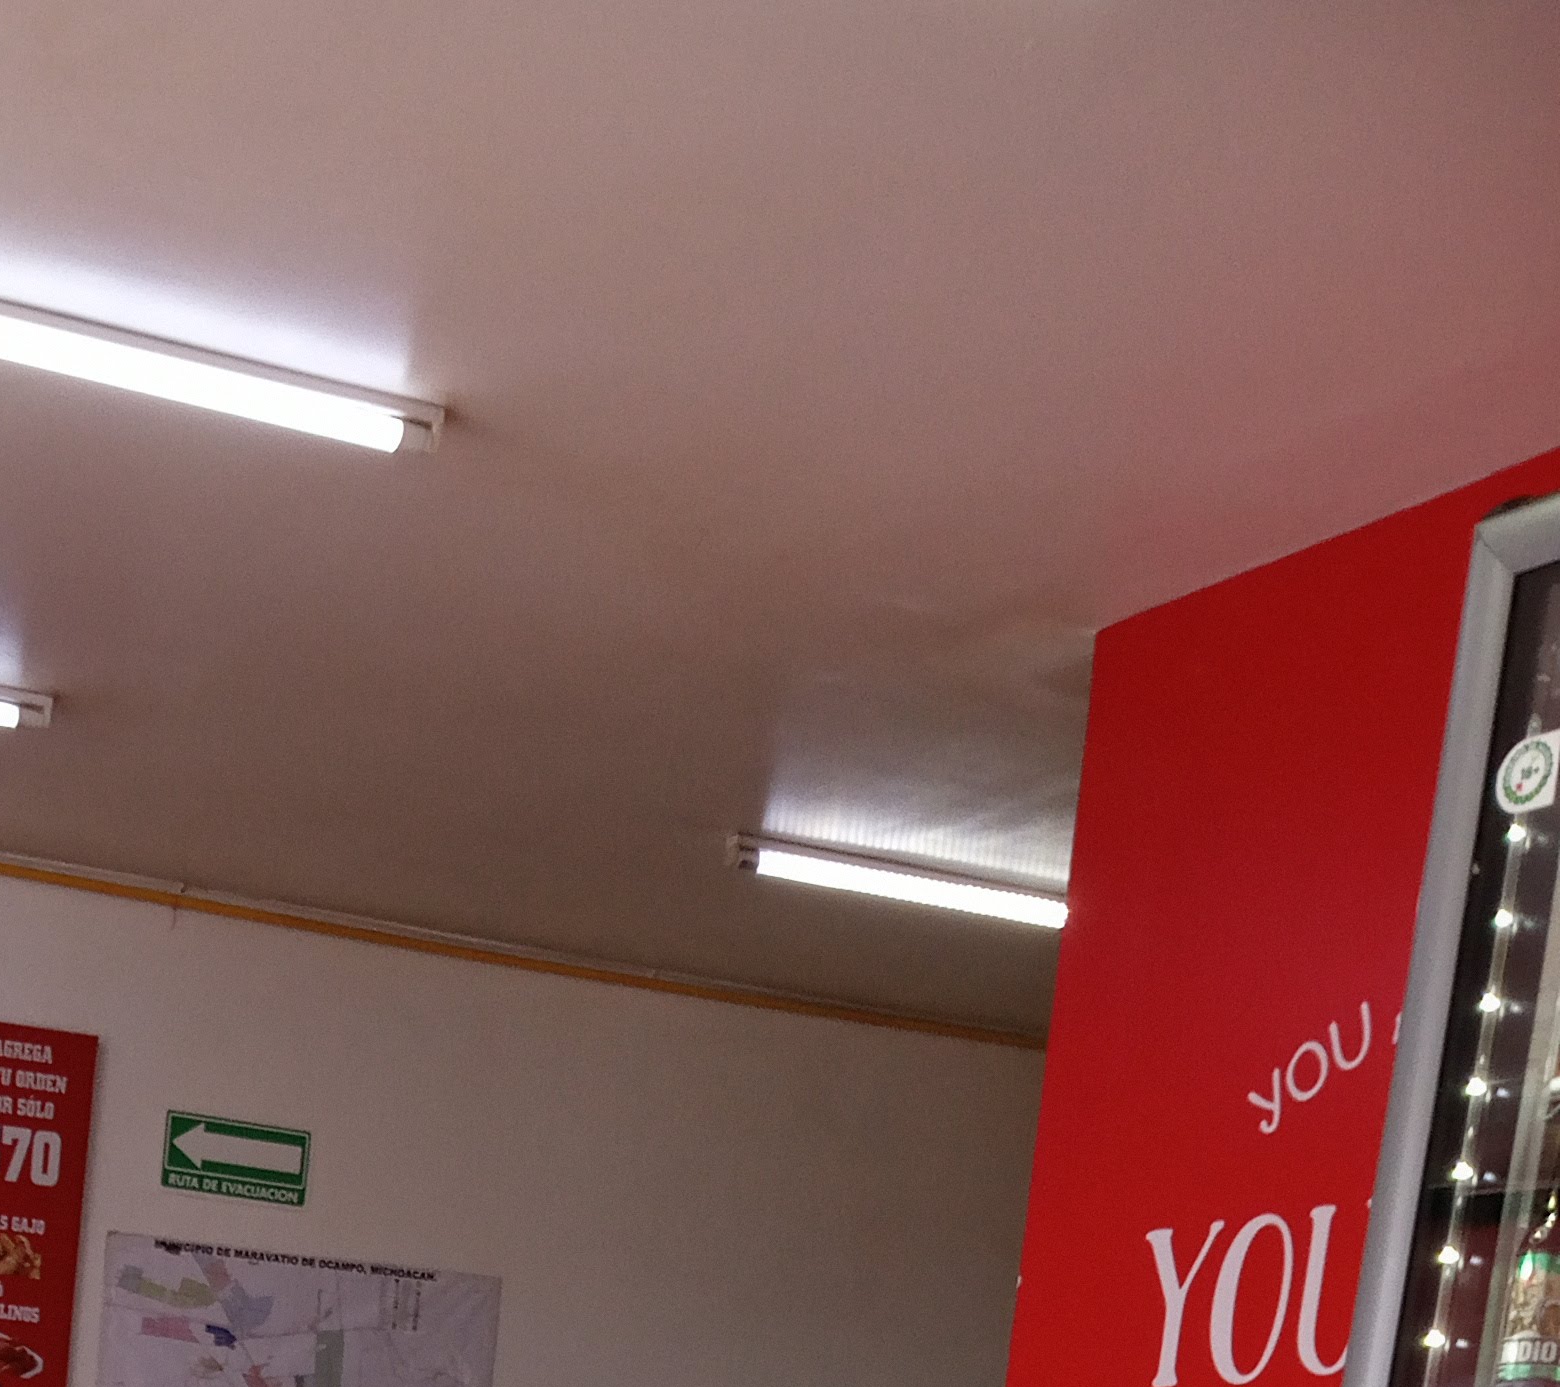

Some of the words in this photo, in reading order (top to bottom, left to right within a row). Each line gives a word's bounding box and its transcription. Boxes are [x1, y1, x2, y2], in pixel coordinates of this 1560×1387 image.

[15, 1069, 69, 1095] ORDEN
[168, 1172, 200, 1190] RUTA
[202, 1178, 219, 1192] DE
[221, 1180, 299, 1204] EVACUACION
[11, 1215, 46, 1235] GAJO
[216, 1246, 232, 1259] DE
[234, 1249, 299, 1266] MARAVATIO
[301, 1257, 317, 1269] DE
[1501, 1340, 1557, 1363] DIO
